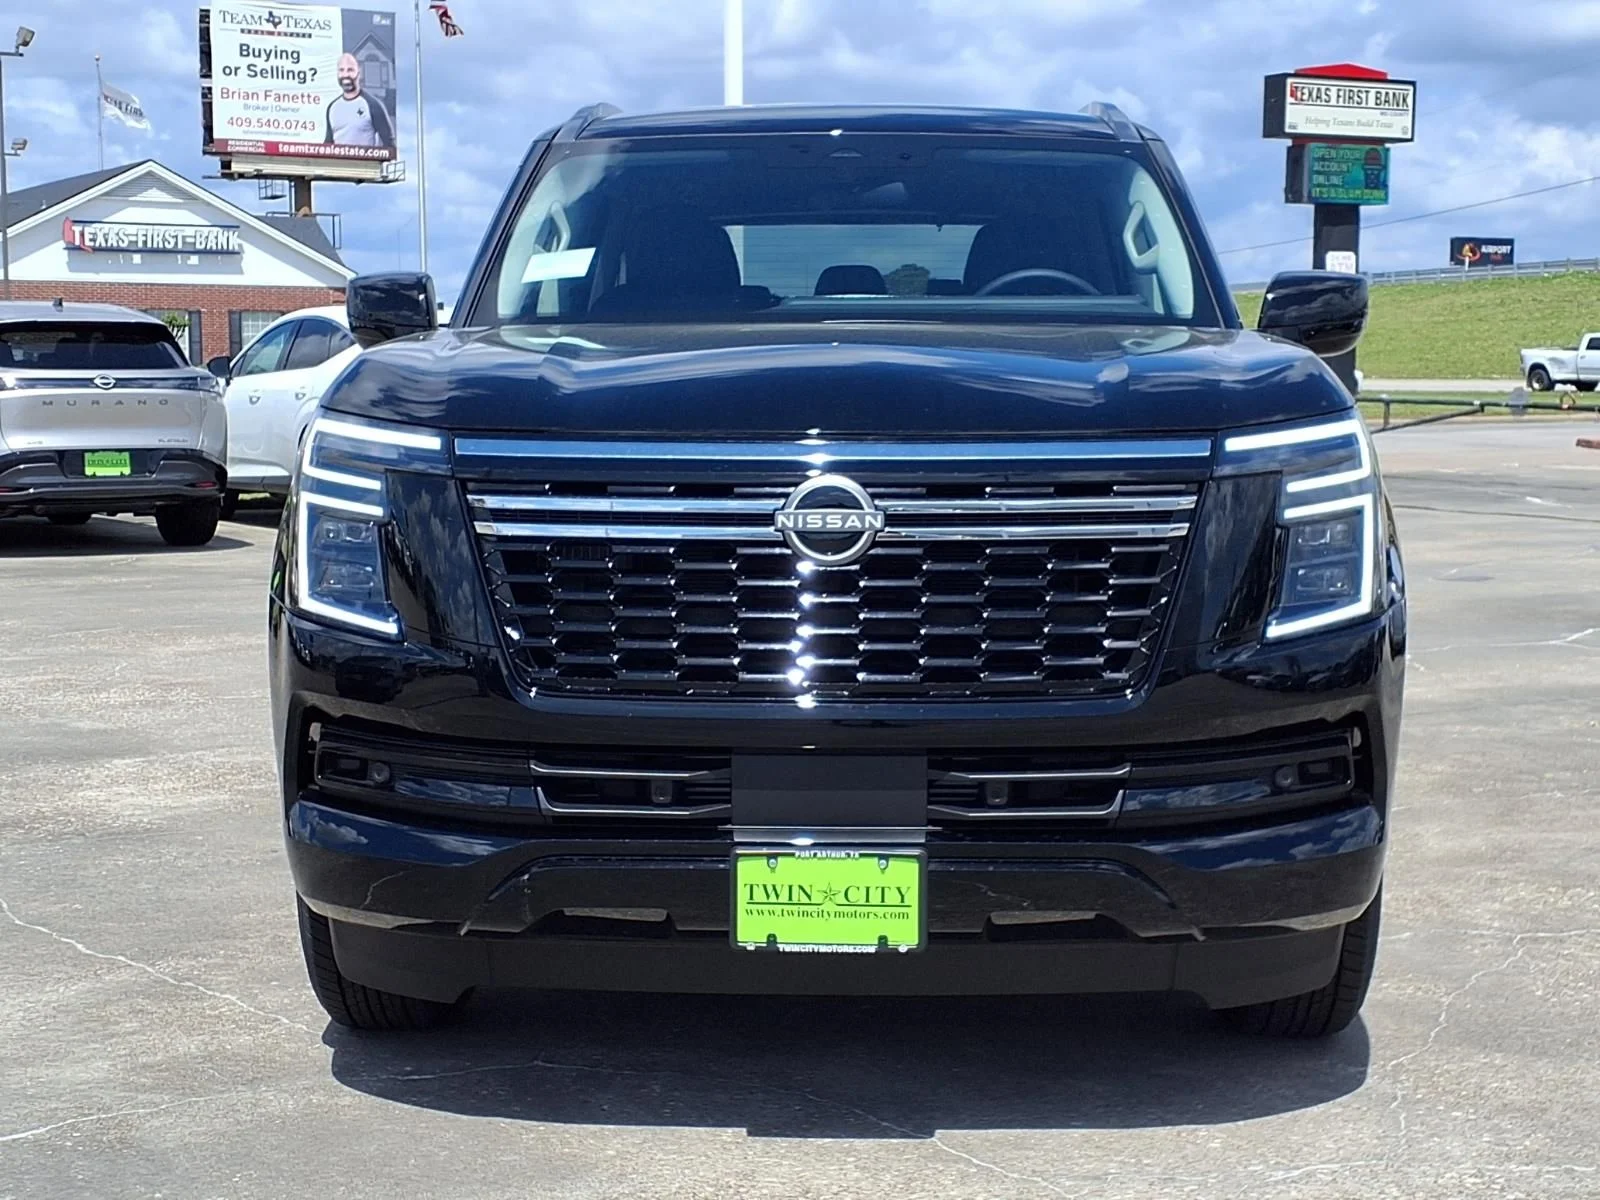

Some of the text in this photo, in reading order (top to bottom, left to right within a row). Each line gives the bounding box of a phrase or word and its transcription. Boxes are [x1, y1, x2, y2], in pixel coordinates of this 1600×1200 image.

[219, 10, 332, 30] TEAM TEXAS
[239, 43, 301, 64] Buying
[222, 64, 318, 84] or Selling?
[220, 87, 321, 105] Brian Fanette
[1294, 85, 1410, 108] TEXAS FIRST BANK
[227, 116, 316, 131] 409.540.0743
[278, 143, 389, 158] teamtxrealestate.com
[72, 226, 240, 250] TEXAS FIRST BANK
[42, 399, 169, 407] MURANO
[777, 514, 882, 528] NISSAN
[743, 883, 911, 903] TWIN CITY
[744, 907, 910, 921] www.twincitymotors.com
[779, 944, 877, 953] TWINCITYMOTORS.COM
